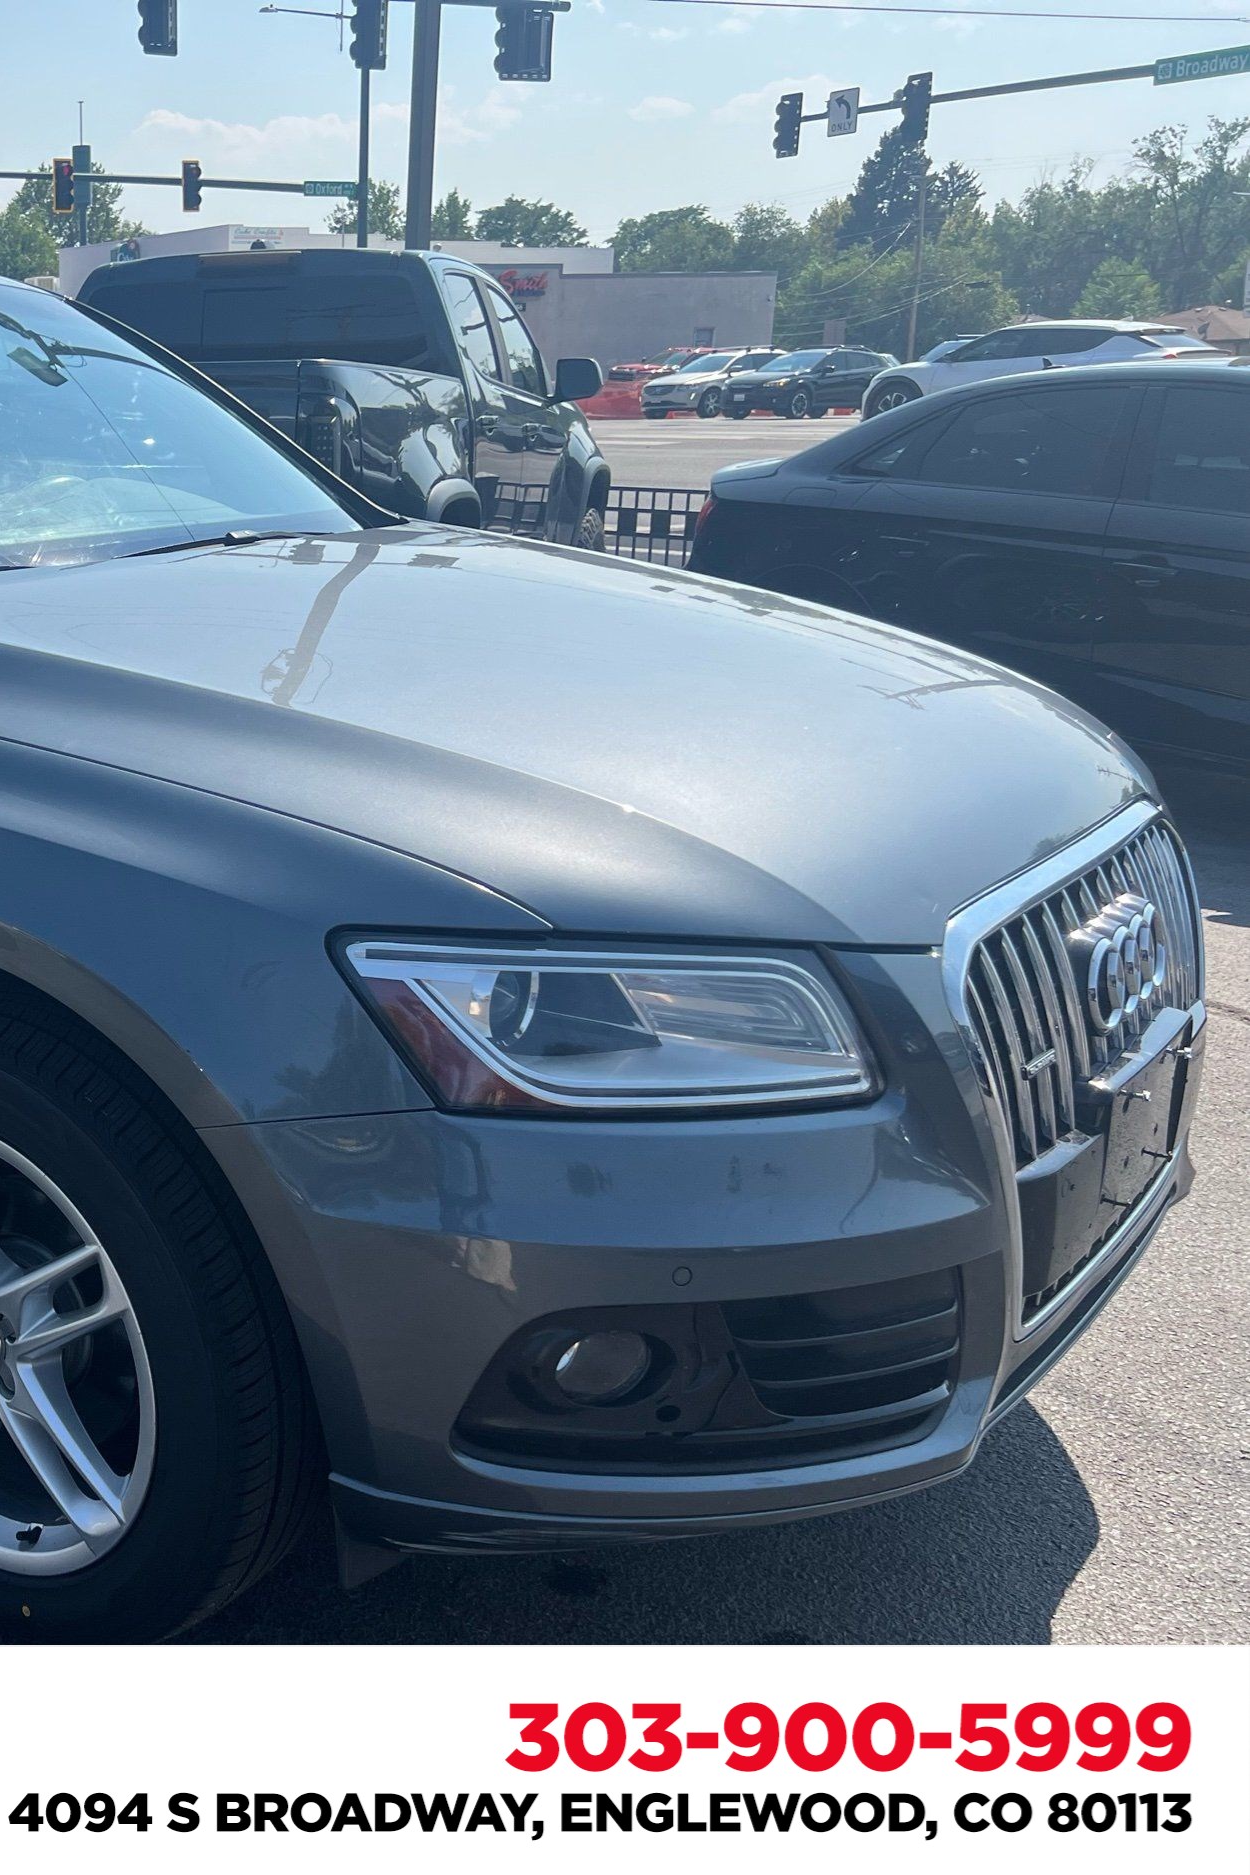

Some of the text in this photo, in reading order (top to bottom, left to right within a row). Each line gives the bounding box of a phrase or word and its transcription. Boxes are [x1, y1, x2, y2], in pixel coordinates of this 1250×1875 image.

[1175, 53, 1250, 77] Broadway
[831, 121, 853, 132] ONLY
[315, 183, 343, 195] Oxford
